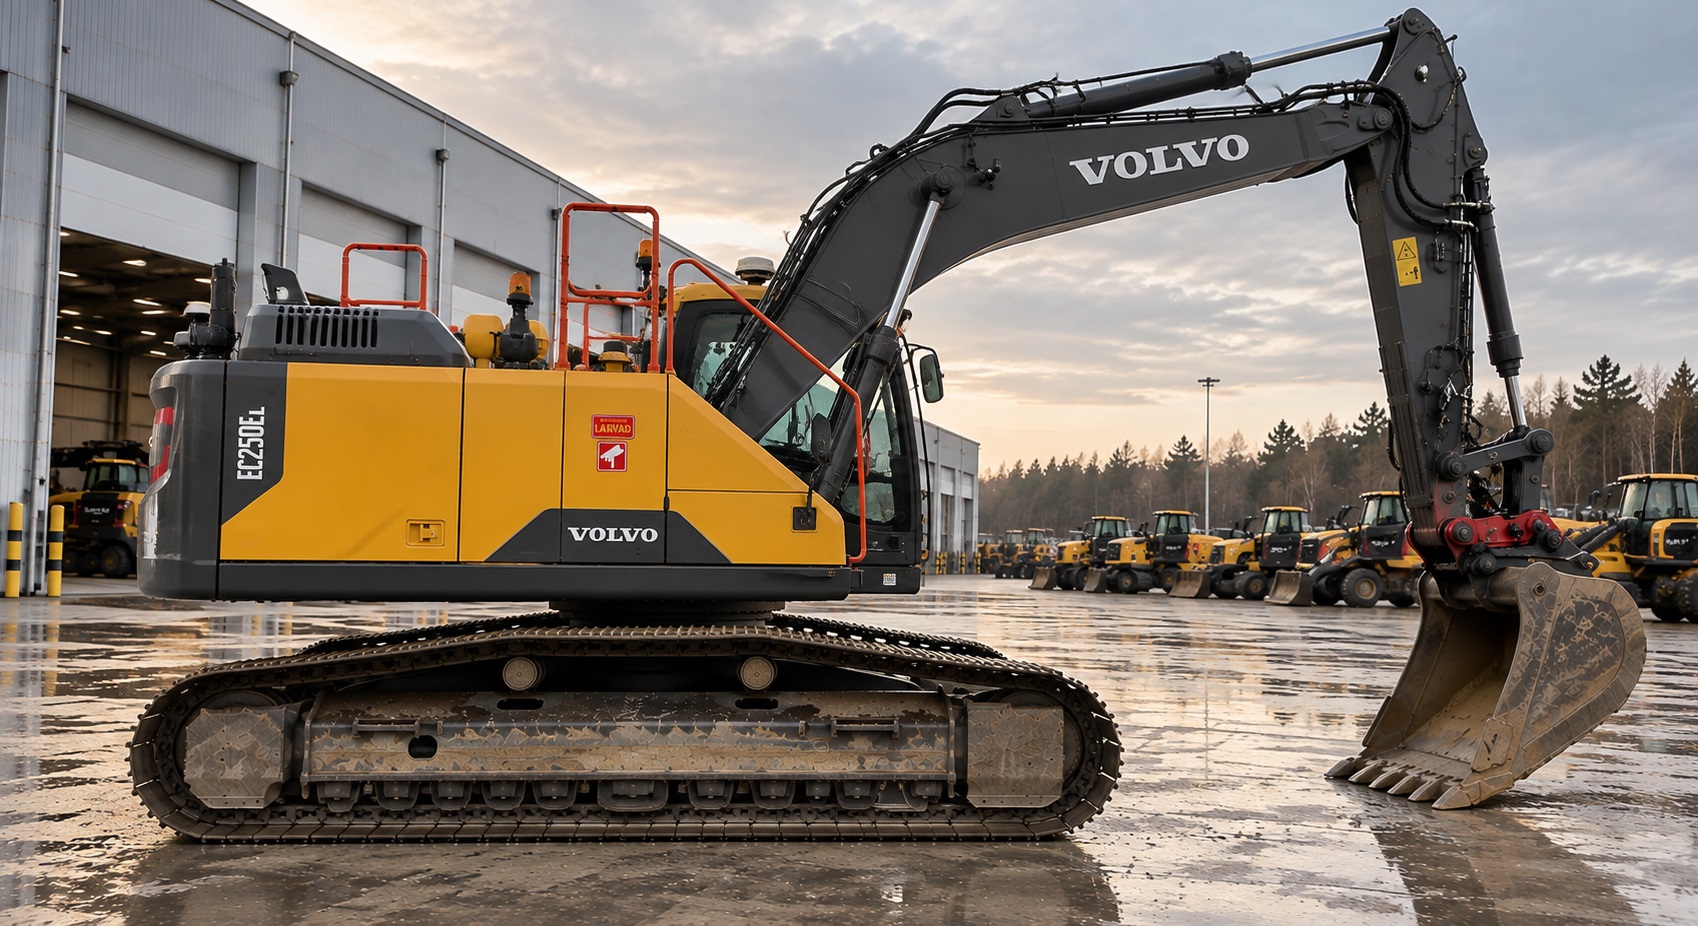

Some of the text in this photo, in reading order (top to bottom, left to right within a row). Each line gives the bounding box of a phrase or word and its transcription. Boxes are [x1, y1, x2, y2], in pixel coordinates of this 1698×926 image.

[1069, 134, 1250, 186] VOLVO
[595, 423, 632, 434] LARVAD
[568, 527, 659, 543] VOLVO
